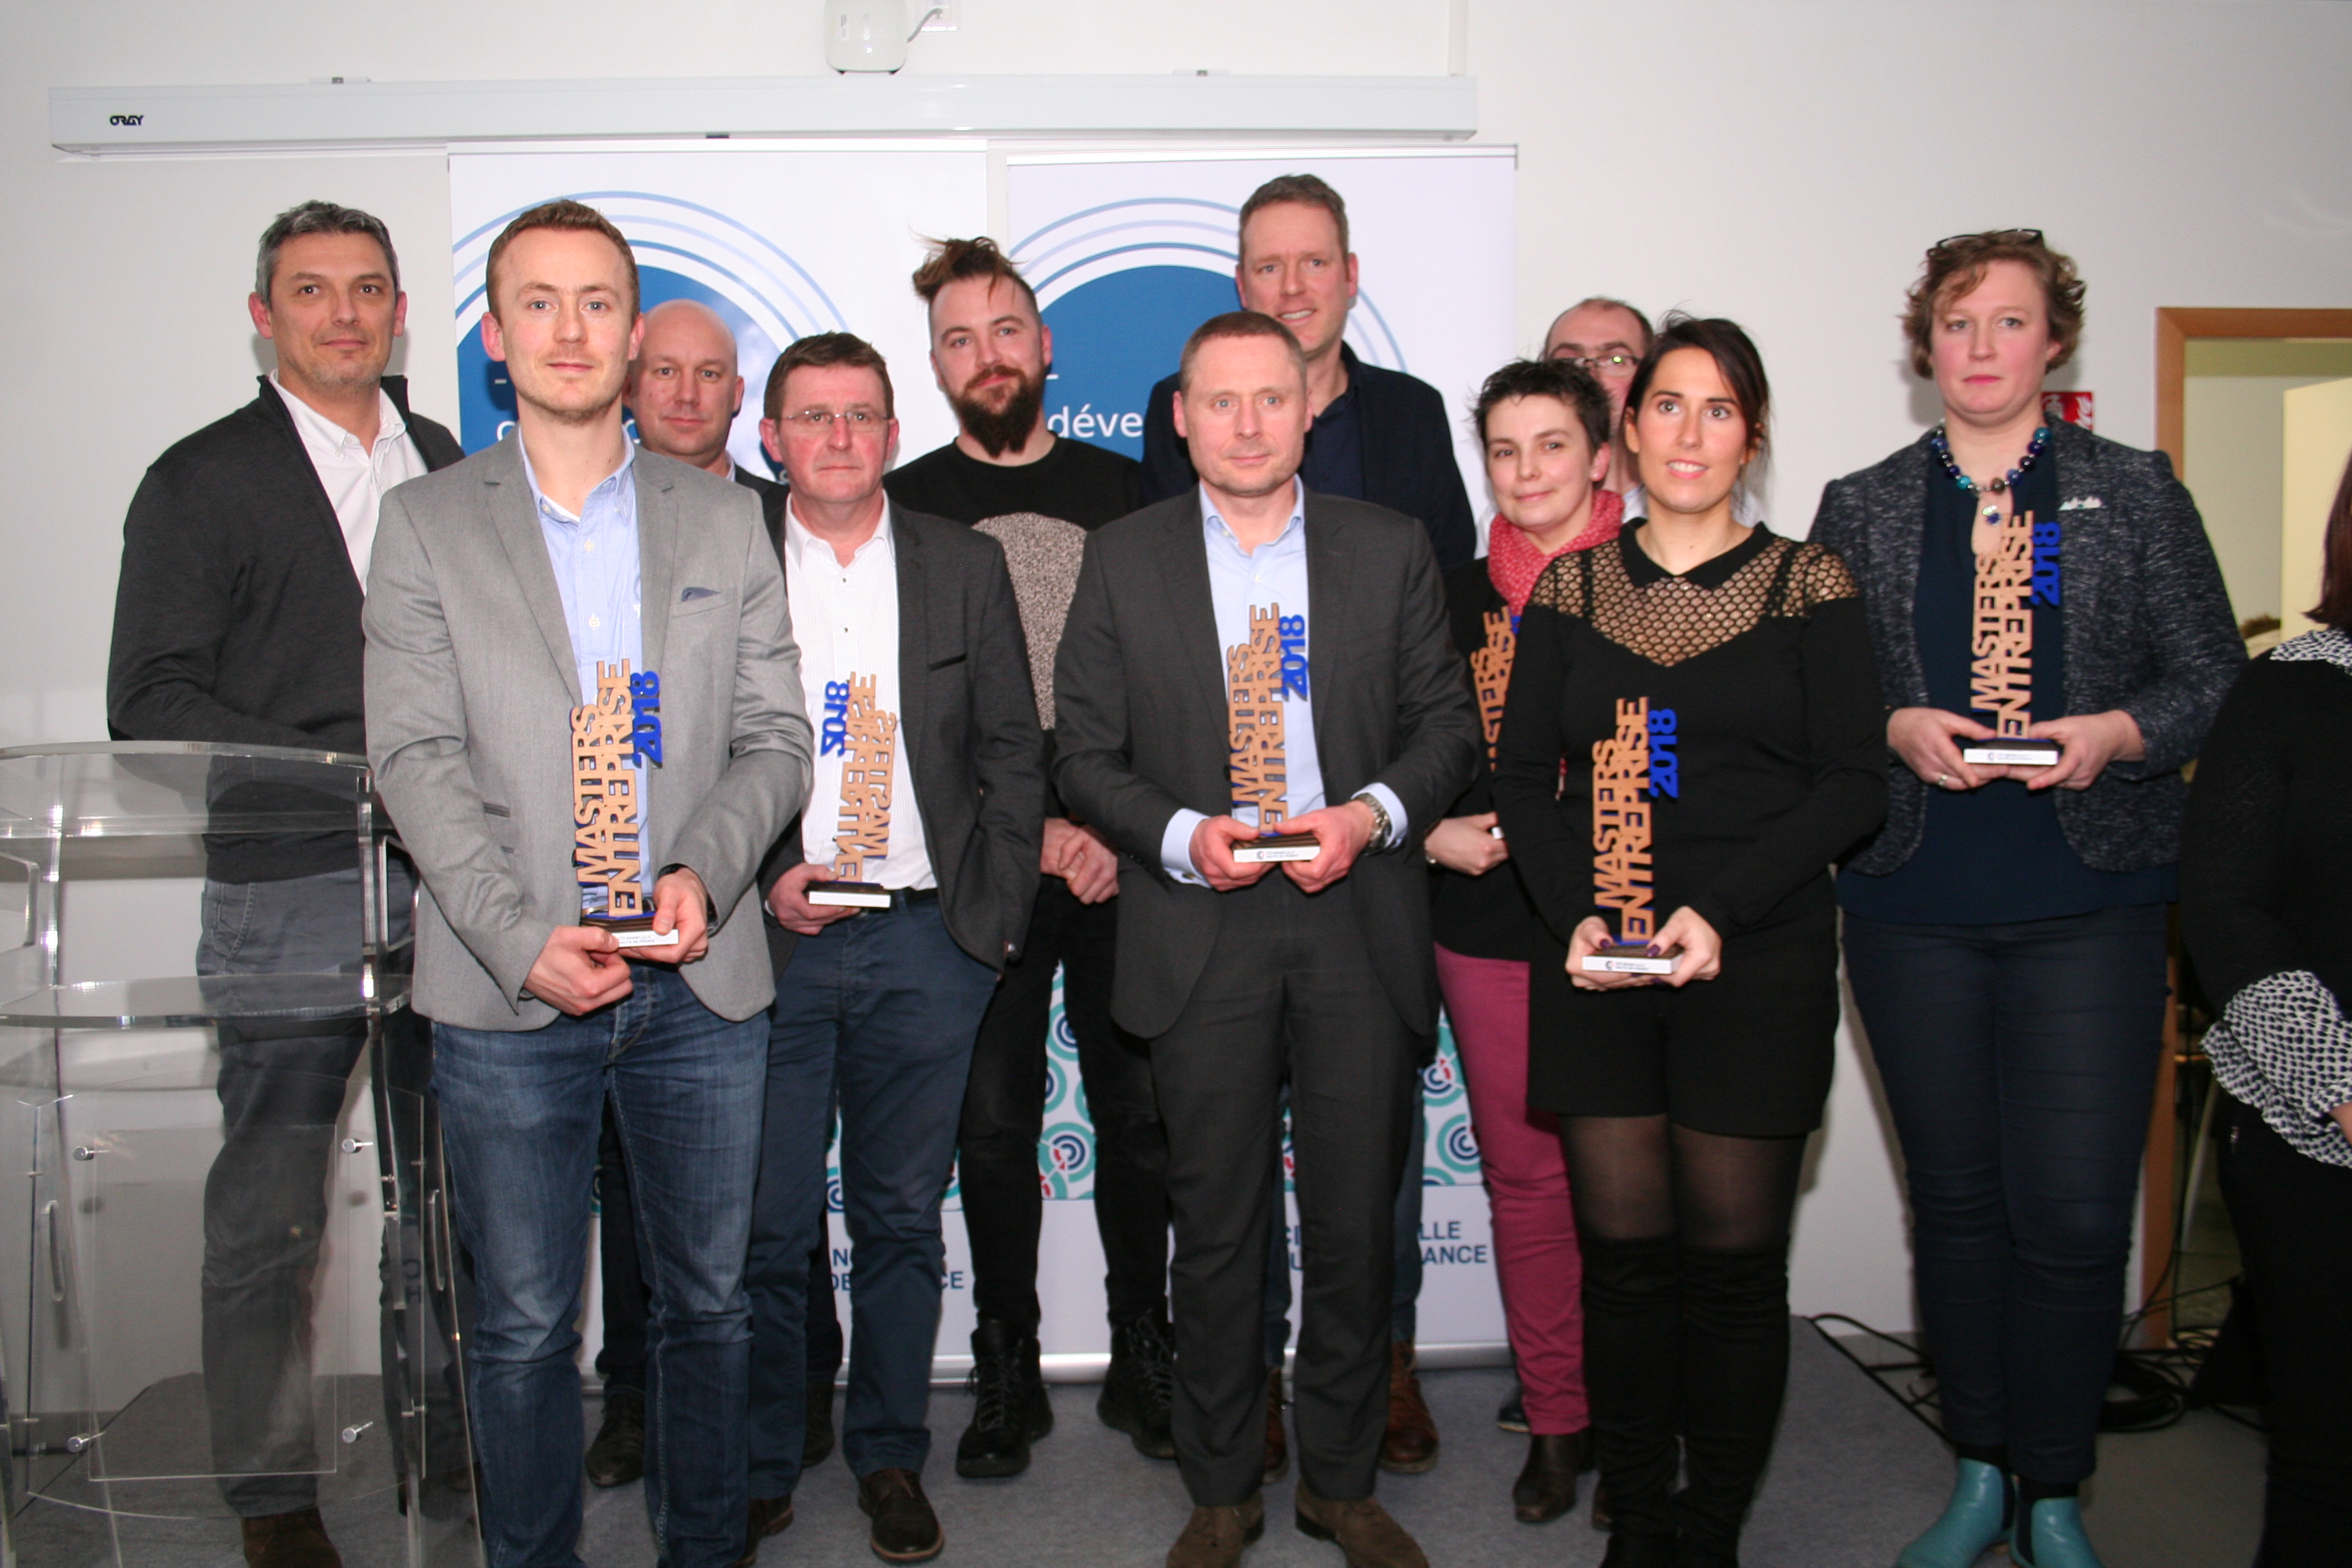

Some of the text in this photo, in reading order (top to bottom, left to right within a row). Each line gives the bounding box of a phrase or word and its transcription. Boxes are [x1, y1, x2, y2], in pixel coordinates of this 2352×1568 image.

[110, 115, 144, 126] ORAY
[1047, 404, 1143, 438] déve
[1997, 510, 2034, 738] ENTREPRISE
[2029, 522, 2061, 606] 2018
[1279, 615, 1308, 701] 2018
[1970, 553, 2004, 712] MASTERS
[632, 671, 663, 768] 2018
[1226, 643, 1259, 804] MASTERS
[1250, 602, 1289, 834] ENTREPRISE
[1648, 708, 1679, 798] 2018
[571, 704, 610, 884] MASTERS
[597, 659, 642, 917] ENTREPRISE
[1592, 739, 1626, 909] MASTERS
[1616, 696, 1655, 941] ENTREPRISE
[1420, 1221, 1461, 1241] LLE
[1422, 1245, 1488, 1264] ANCE
